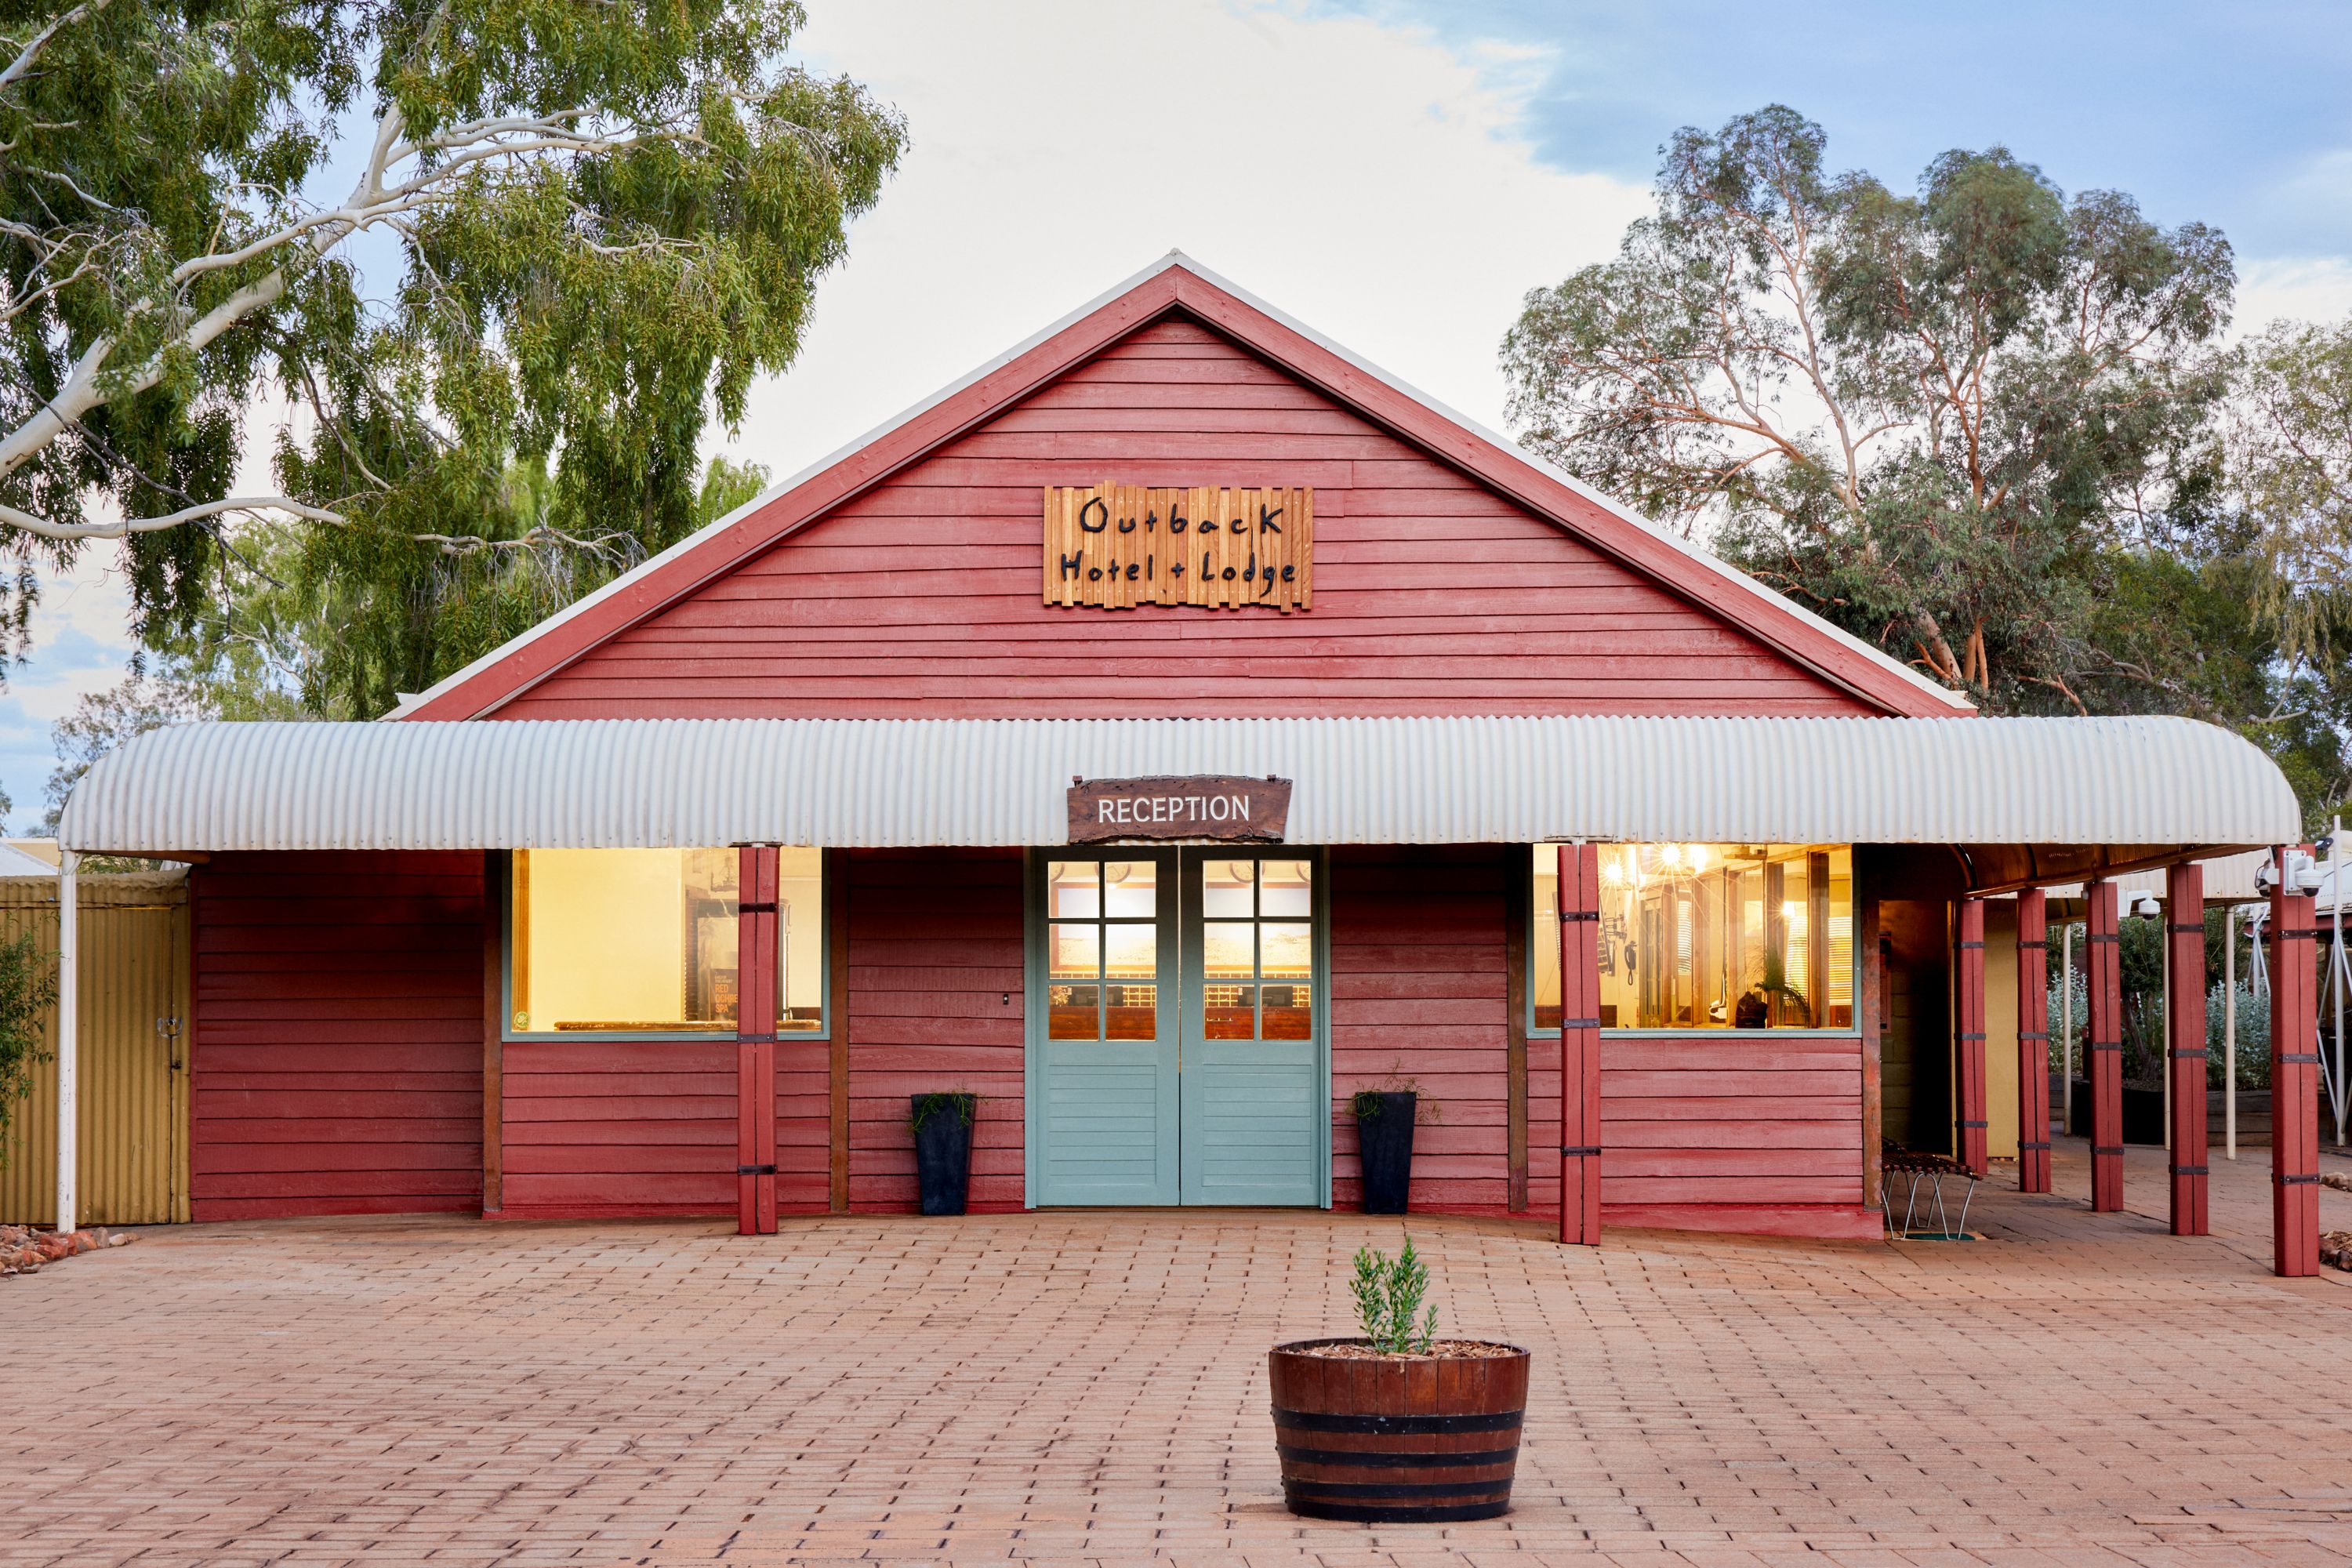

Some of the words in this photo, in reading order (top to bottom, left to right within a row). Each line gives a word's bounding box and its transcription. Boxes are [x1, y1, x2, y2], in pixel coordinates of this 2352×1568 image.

[1062, 550, 1153, 581] Hotel
[1202, 551, 1295, 597] Lodge
[1098, 795, 1249, 823] RECEPTION
[715, 983, 728, 993] RED
[715, 993, 738, 1004] OCHRE
[715, 1003, 728, 1013] SPA
